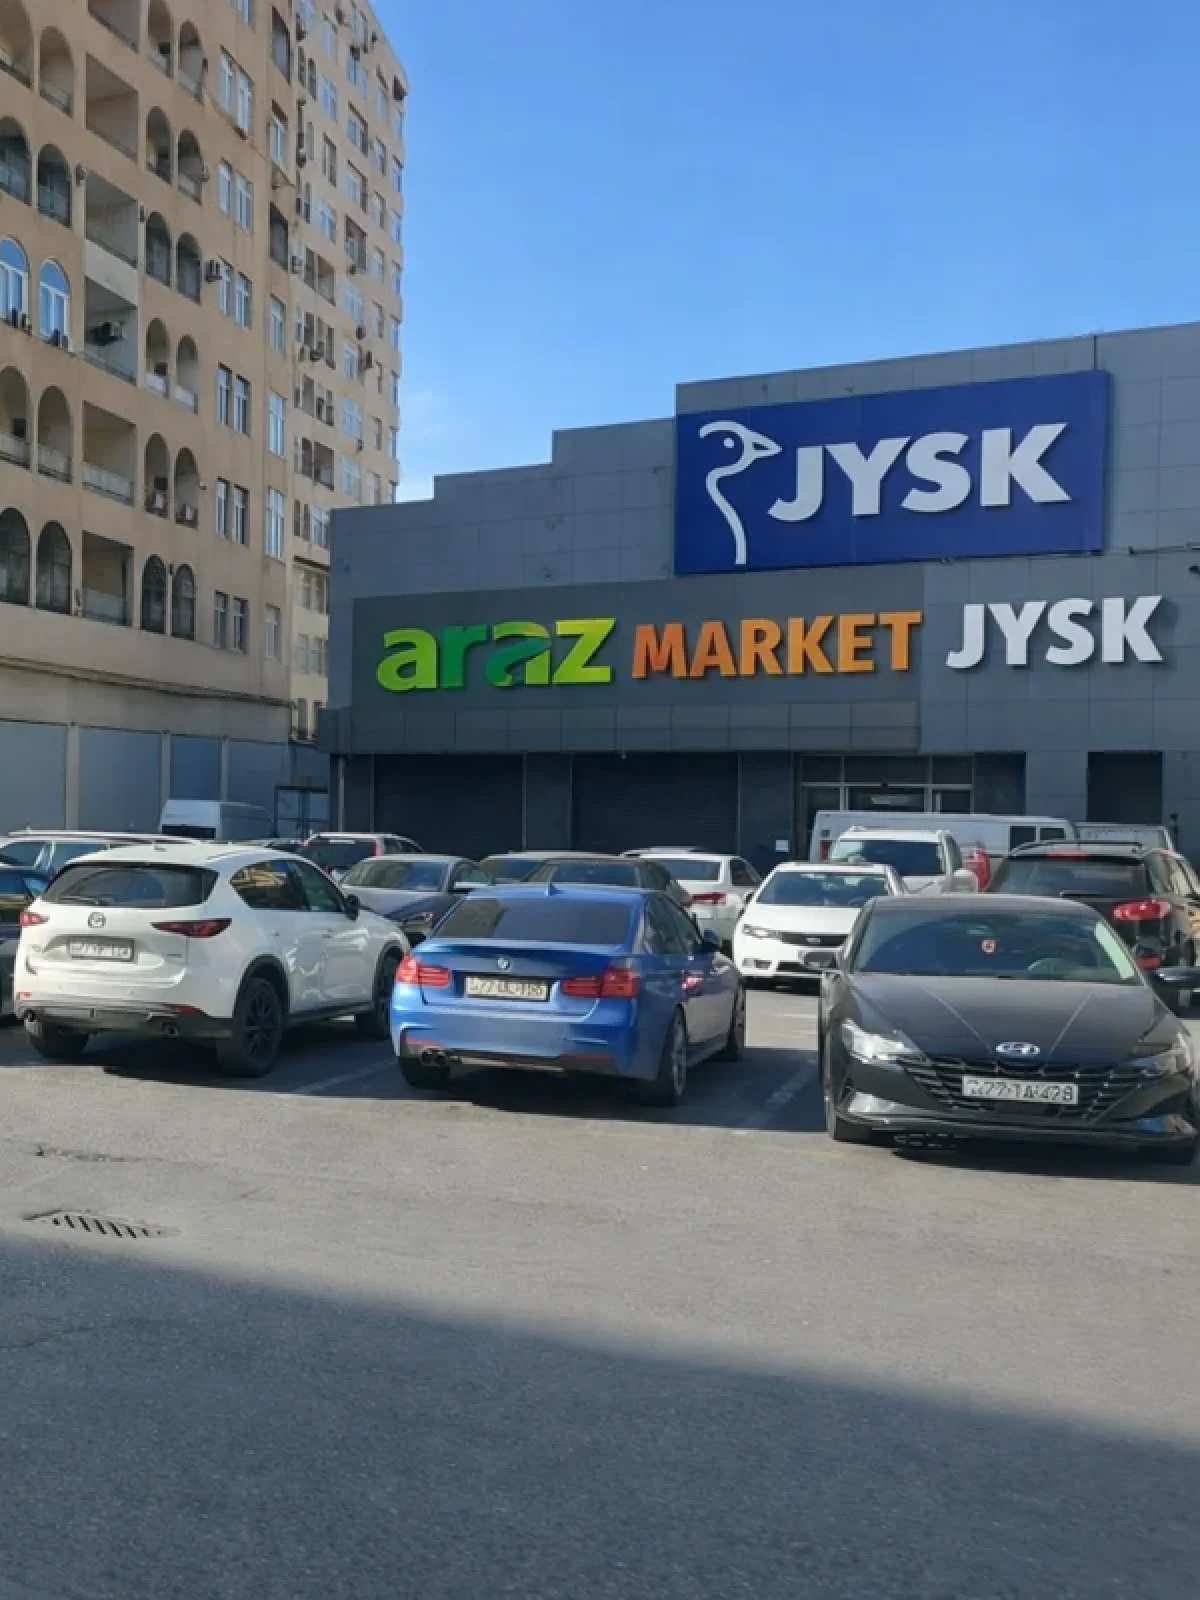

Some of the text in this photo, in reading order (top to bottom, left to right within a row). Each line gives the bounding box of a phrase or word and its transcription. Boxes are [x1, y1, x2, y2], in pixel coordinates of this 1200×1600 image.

[767, 422, 1072, 522] JYSK
[376, 611, 924, 691] araz MARKET
[946, 595, 1164, 669] JYSK
